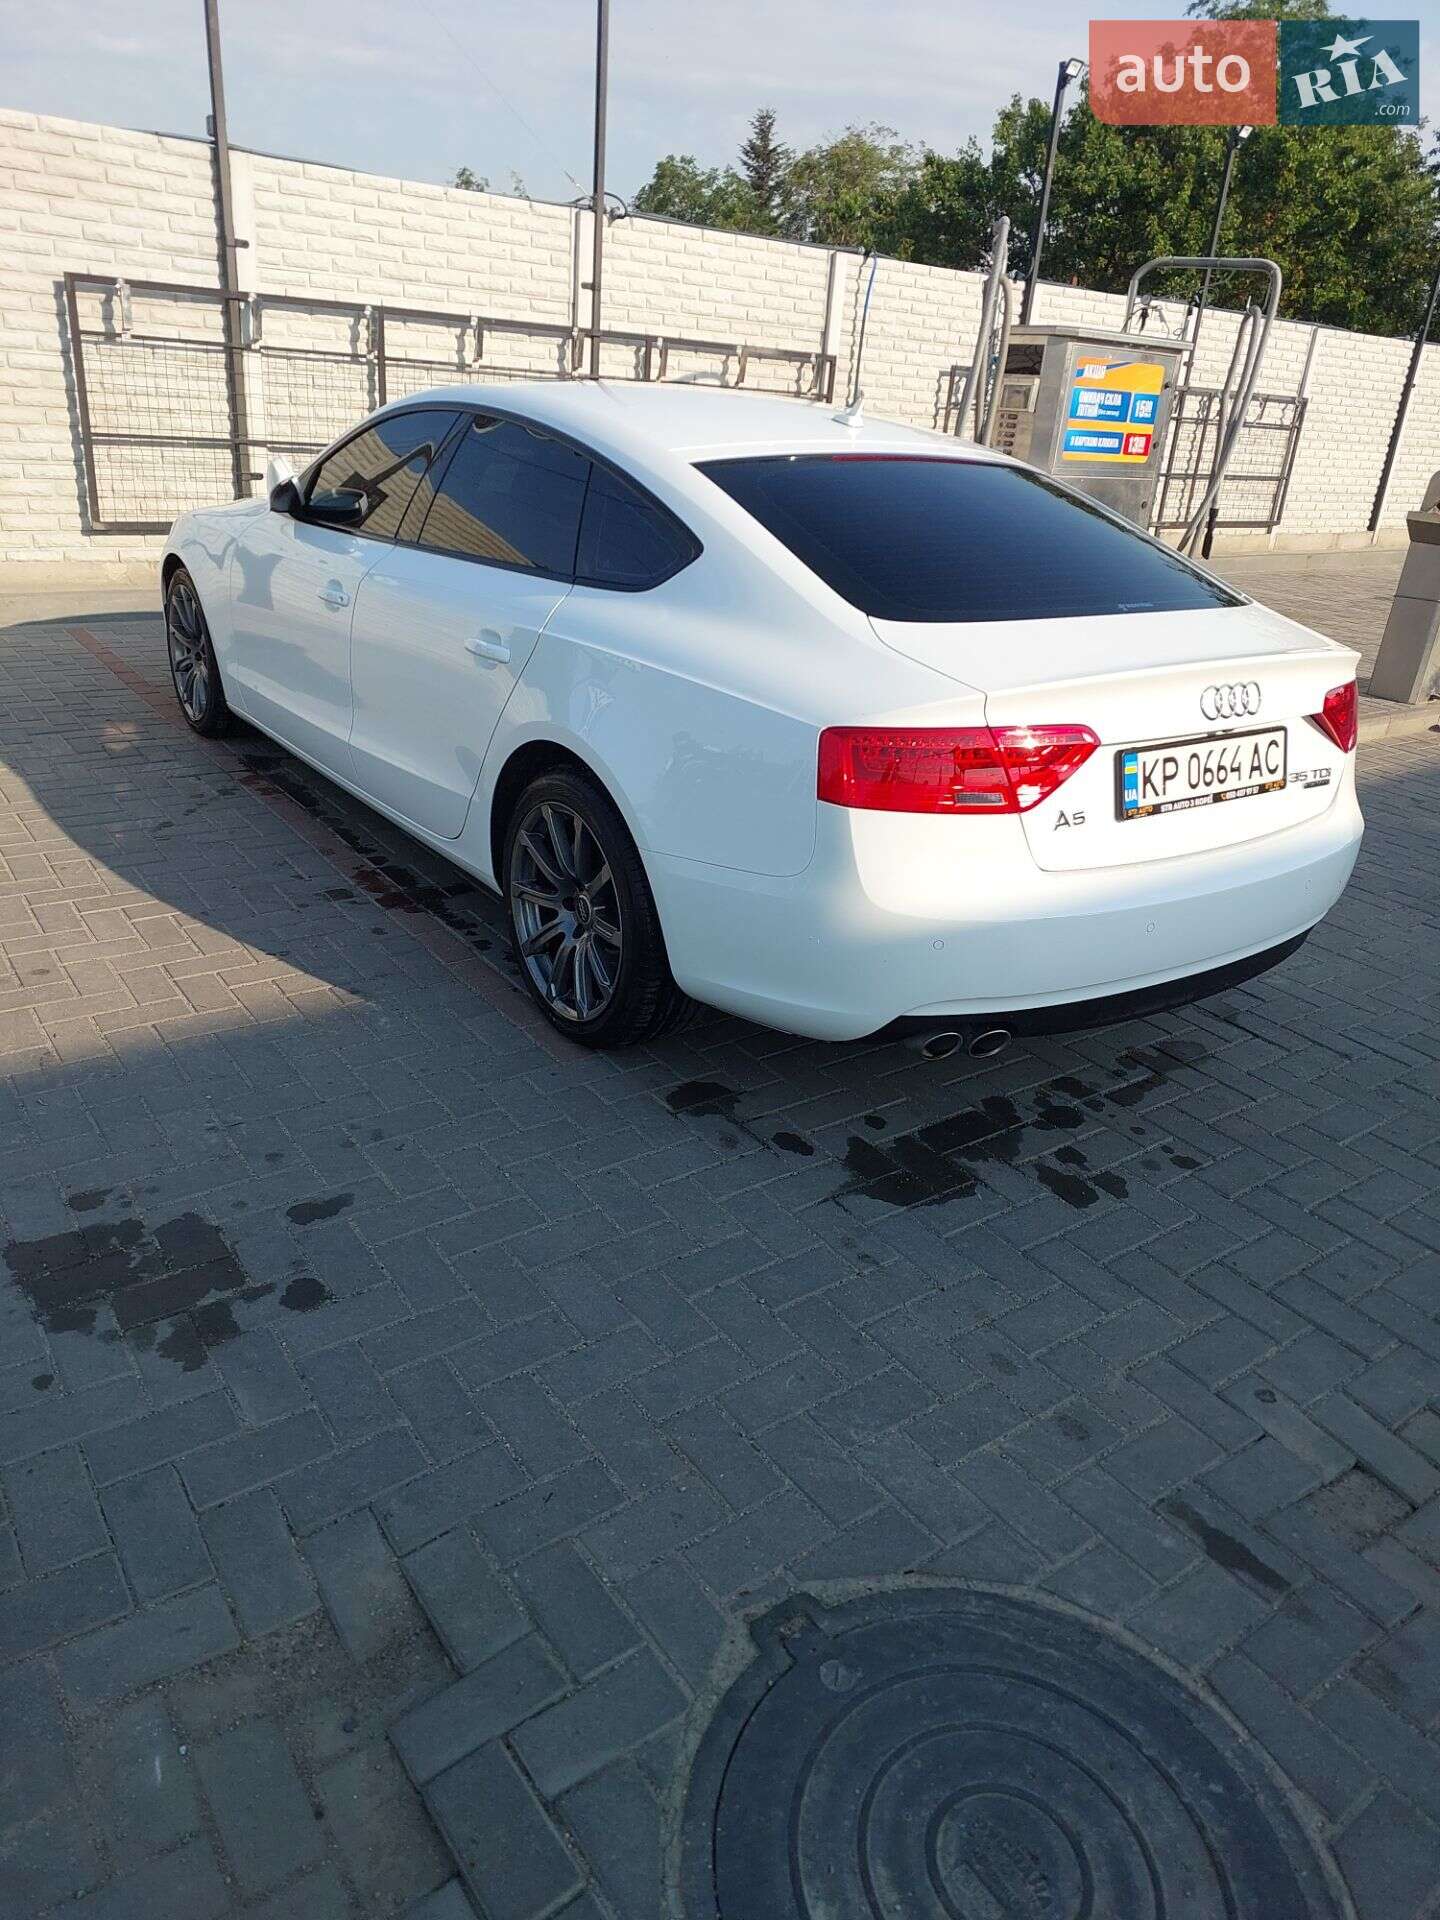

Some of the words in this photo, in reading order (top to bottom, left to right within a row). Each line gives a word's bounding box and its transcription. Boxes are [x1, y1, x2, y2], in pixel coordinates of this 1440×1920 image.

[1142, 756, 1179, 799] KP
[1188, 745, 1242, 791] 0664
[1249, 739, 1281, 779] AC
[1125, 789, 1138, 802] UA
[1054, 809, 1086, 832] A5
